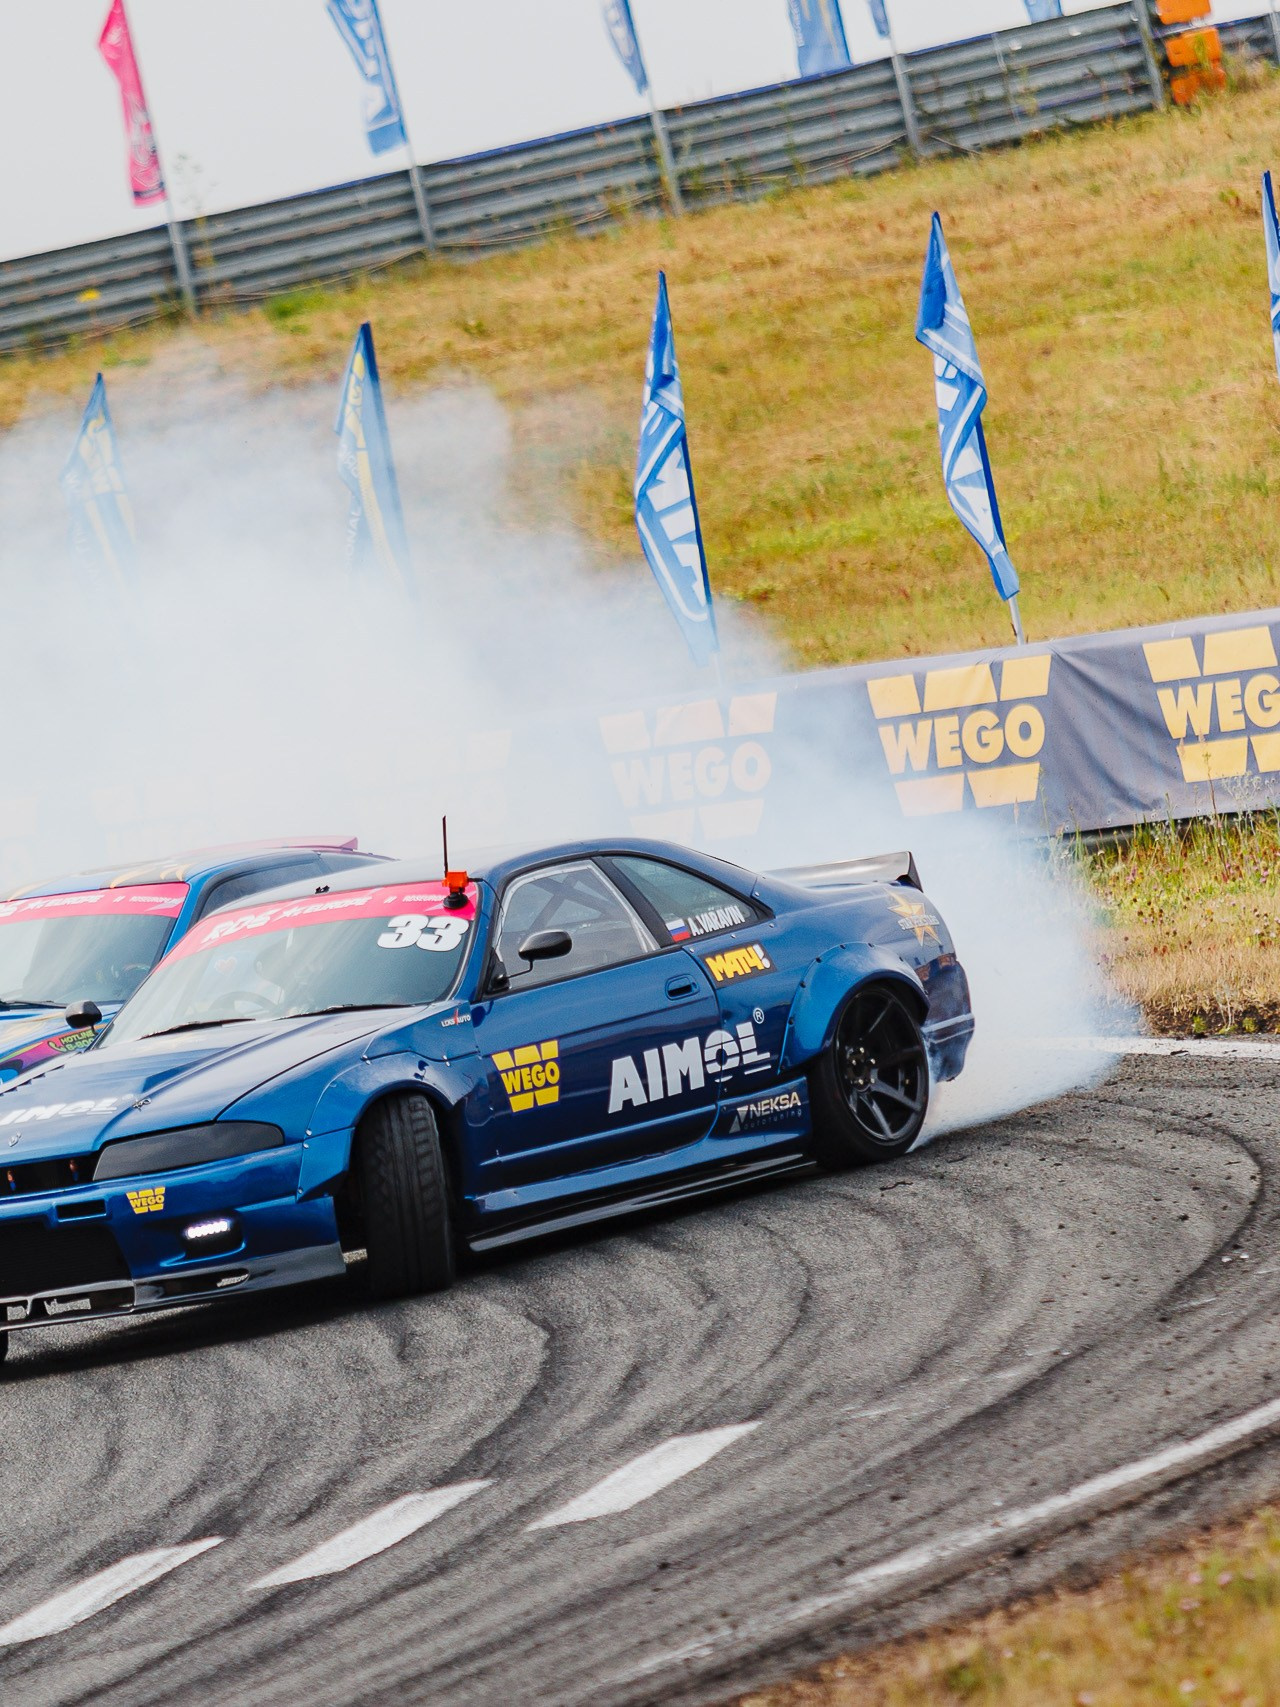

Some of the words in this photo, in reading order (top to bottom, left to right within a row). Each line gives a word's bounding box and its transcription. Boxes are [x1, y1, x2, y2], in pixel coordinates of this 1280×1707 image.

[1156, 673, 1280, 739] WEG
[877, 703, 1046, 774] WEGO
[610, 740, 773, 811] WEGO
[377, 914, 469, 952] 33
[687, 904, 746, 937] A.VARAVIN
[60, 1029, 95, 1045] HOTLINE
[500, 1061, 560, 1095] WEGO
[608, 1021, 772, 1114] AIMOL
[747, 1091, 801, 1120] NEKSA
[130, 1194, 166, 1207] WEGO
